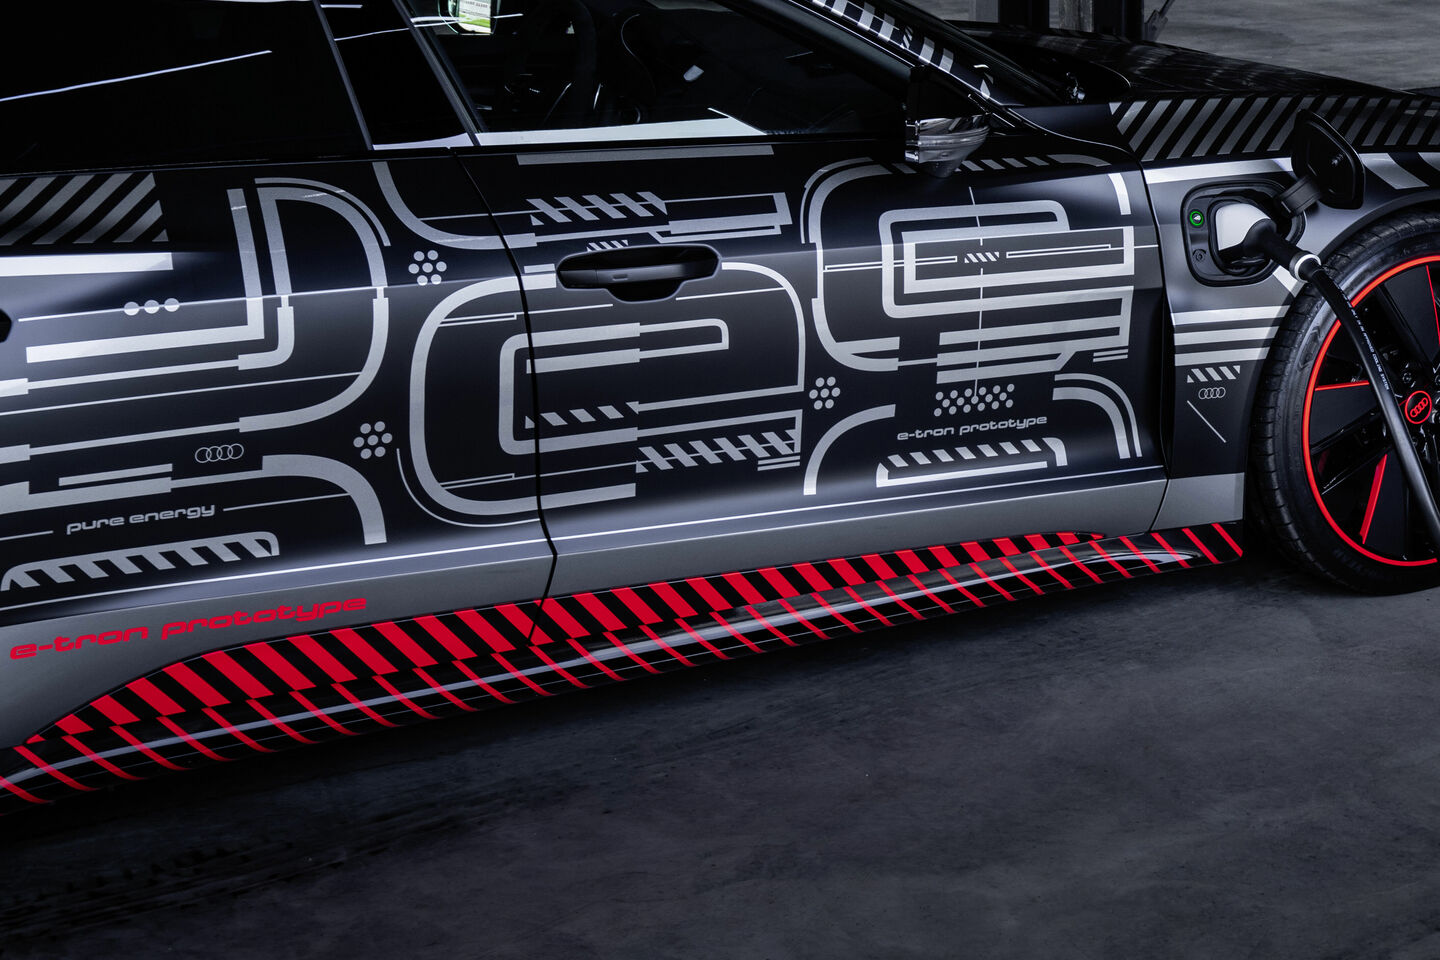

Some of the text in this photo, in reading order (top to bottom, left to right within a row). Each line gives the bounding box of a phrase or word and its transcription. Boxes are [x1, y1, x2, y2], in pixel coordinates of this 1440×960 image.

[897, 416, 1048, 441] e-tron prototype
[66, 504, 216, 535] pure energy
[10, 597, 367, 660] e-tron prototype
